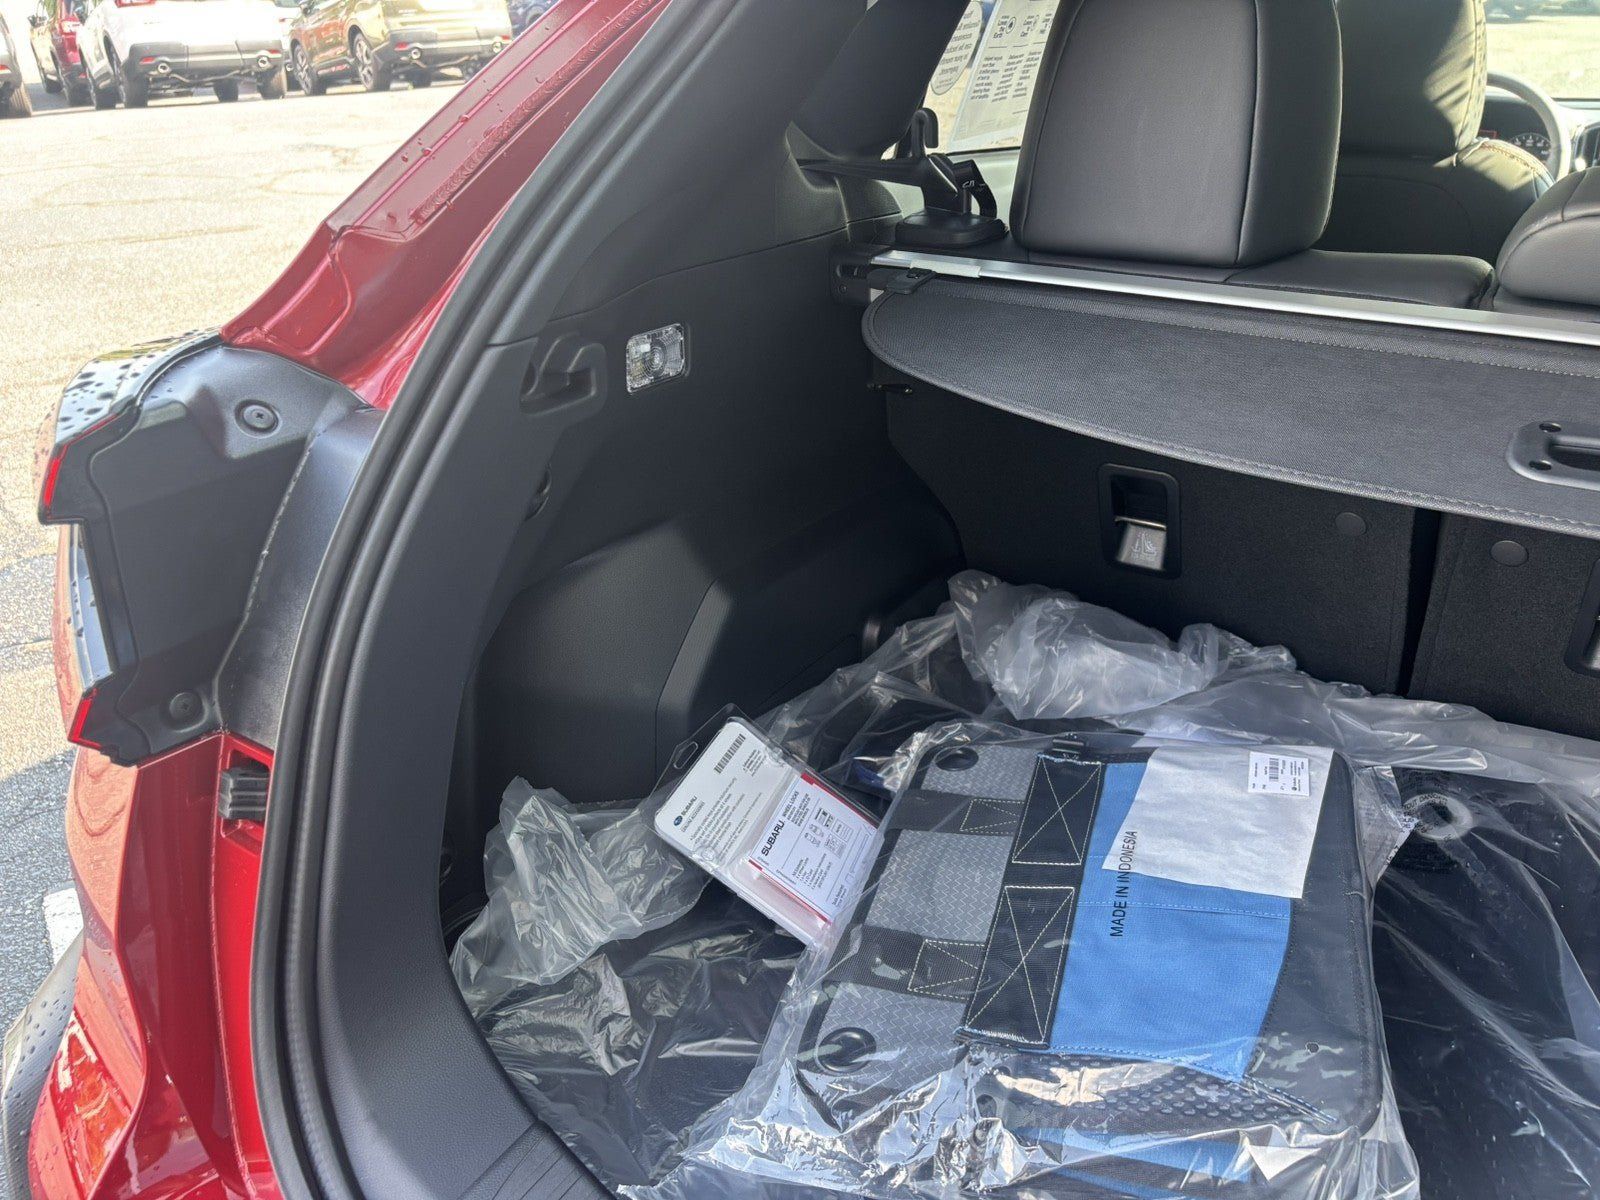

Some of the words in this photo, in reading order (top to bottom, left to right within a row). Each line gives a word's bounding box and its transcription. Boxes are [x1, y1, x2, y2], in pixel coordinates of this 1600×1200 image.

[681, 796, 698, 816] SUBARU
[761, 820, 785, 856] SUBARU
[1118, 830, 1138, 883] INDONESIA
[1117, 888, 1129, 901] IN
[1110, 900, 1128, 937] MADE
